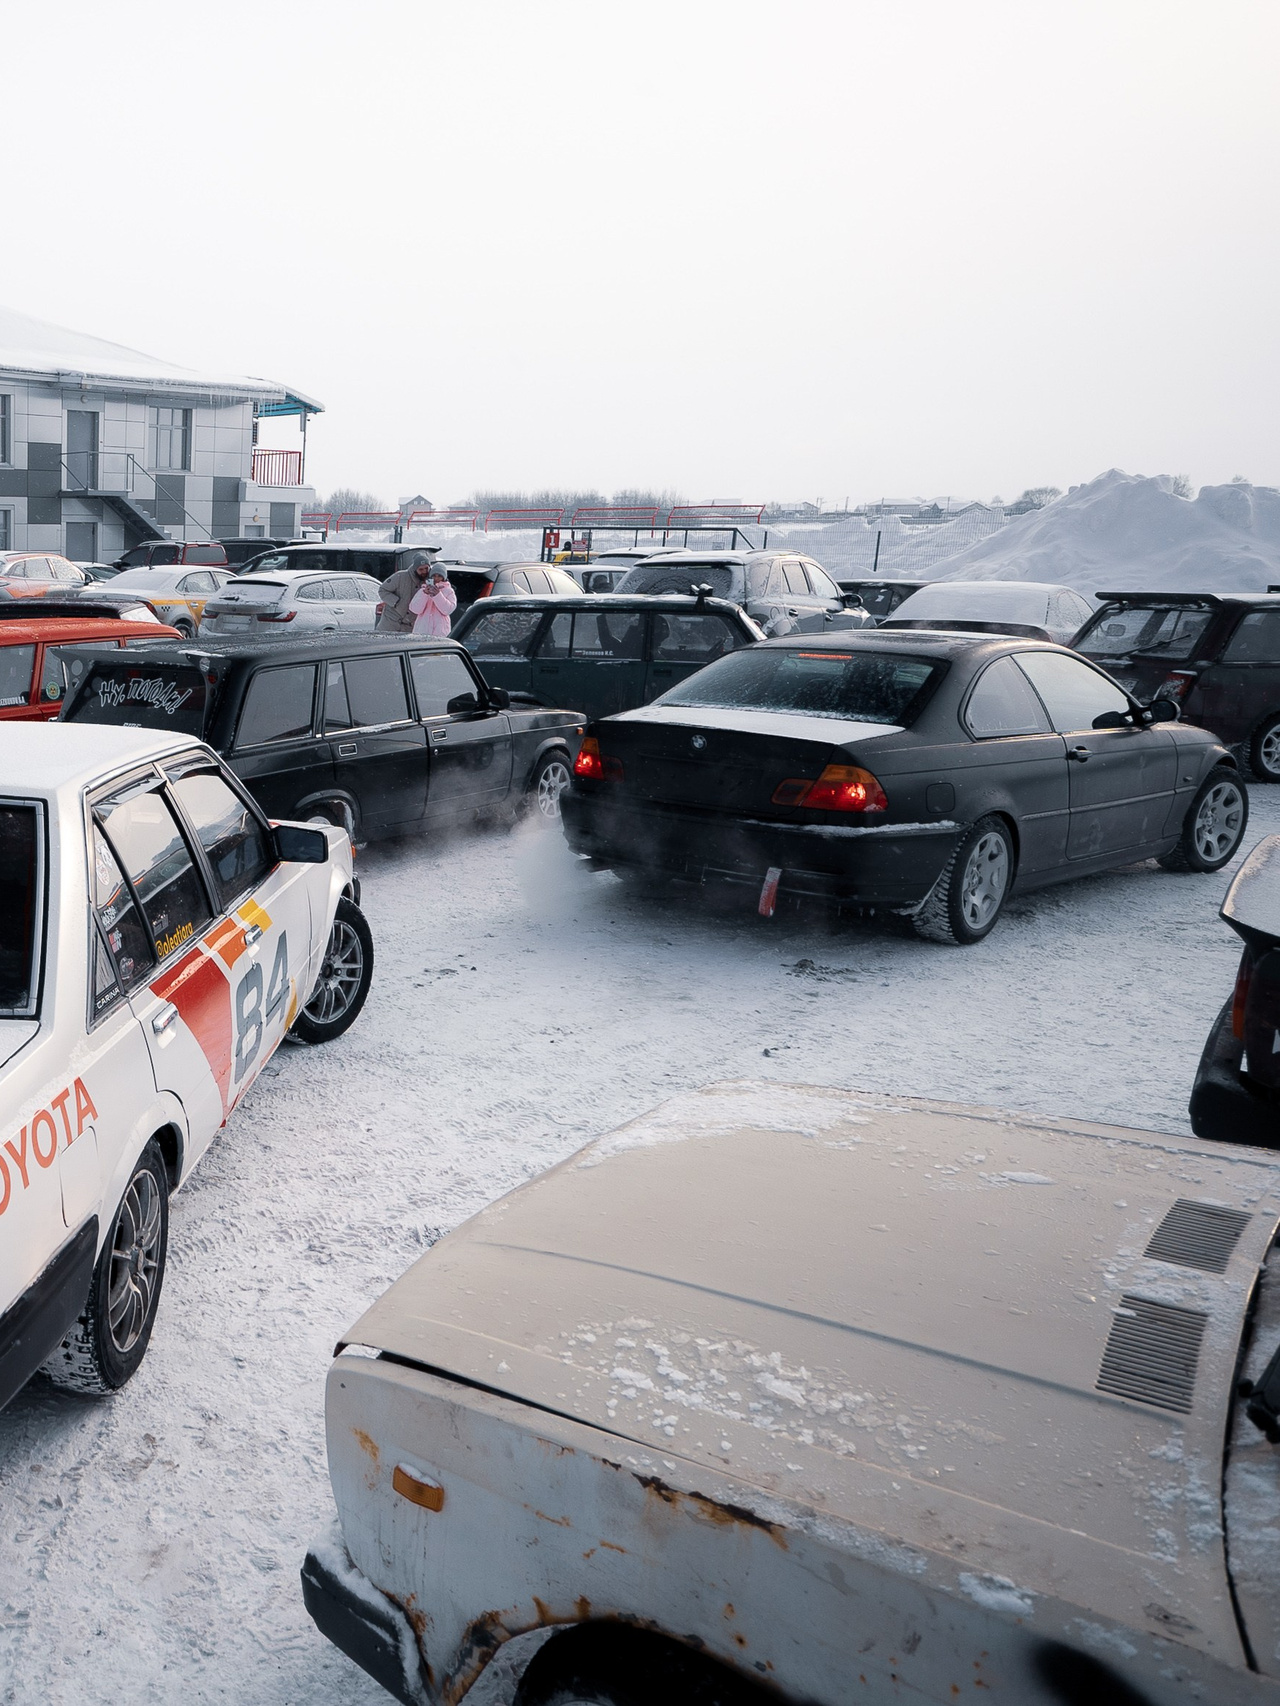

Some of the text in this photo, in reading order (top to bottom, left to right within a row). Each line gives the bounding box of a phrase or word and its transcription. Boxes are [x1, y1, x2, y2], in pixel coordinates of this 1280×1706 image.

[549, 535, 555, 546] 1
[96, 987, 121, 1010] CARINA
[234, 929, 290, 1085] 84
